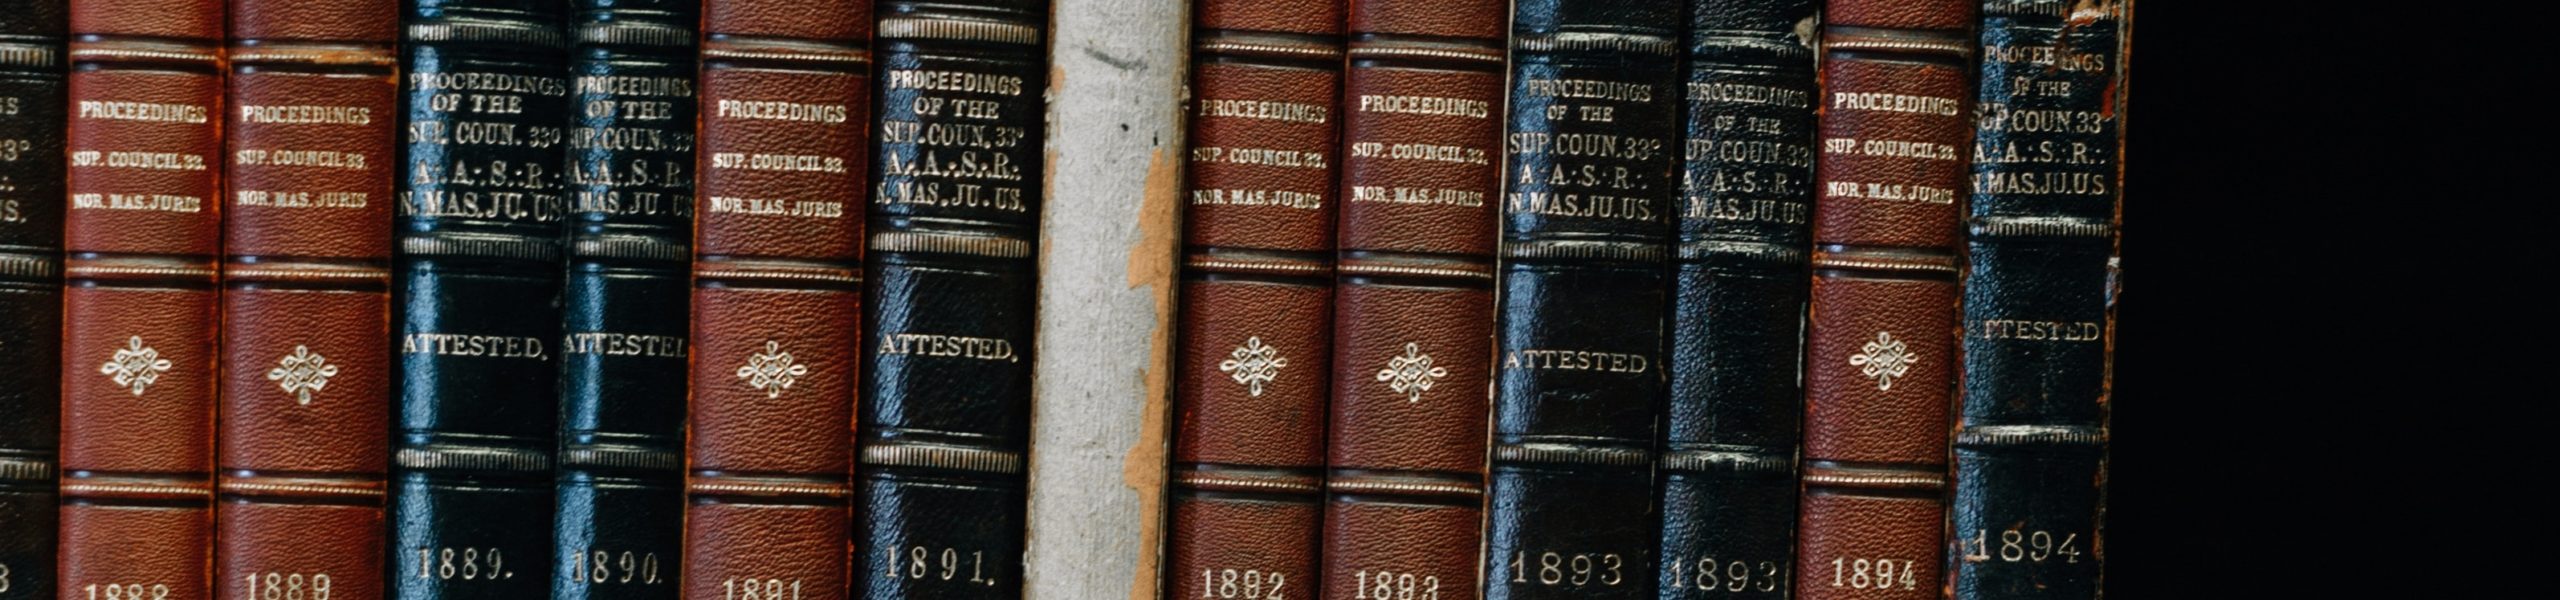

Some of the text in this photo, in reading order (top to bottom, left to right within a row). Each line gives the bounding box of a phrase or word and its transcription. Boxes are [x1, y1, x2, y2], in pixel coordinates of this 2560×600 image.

[409, 72, 566, 97] PROCEEDINGS
[576, 76, 692, 97] PROCEEDINGS
[889, 69, 1023, 97] PROCEEDINGS
[1528, 79, 1651, 102] PROCEEDINGS
[1685, 82, 1808, 108] PROCEEDINGS
[2037, 82, 2071, 96] THE
[80, 100, 207, 124] PROCEEDINGS
[242, 104, 371, 125] PROCEEDINGS
[431, 93, 523, 114] OF THE
[586, 100, 673, 119] OF THE
[718, 100, 847, 123] PROCEEDINGS
[913, 96, 999, 120] OF THE
[1200, 99, 1327, 124] PROCEEDINGS
[1361, 94, 1489, 119] PROCEEDINGS
[1547, 105, 1613, 122] OF THE
[1834, 92, 1958, 116] PROCEEDINGS
[1715, 115, 1782, 134] OF THE
[108, 151, 182, 169] COUNCIL
[273, 150, 345, 167] COUNCIL
[1230, 148, 1302, 167] COUNCIL
[1391, 143, 1464, 163] COUNCIL
[1864, 140, 1937, 158] COUNCIL
[751, 154, 823, 172] COUNCIL
[402, 333, 548, 361] ATTESTED.
[880, 333, 1019, 364] ATTESTED.
[1504, 350, 1647, 374] ATTESTED
[1965, 529, 2081, 563] 1894
[418, 547, 513, 579] 1889.
[886, 545, 995, 586] 1891.
[1510, 551, 1622, 586] 1893
[1670, 557, 1777, 592] 1893
[1832, 556, 1917, 590] 1894
[246, 572, 331, 600] 1889
[1202, 568, 1285, 600] 1892
